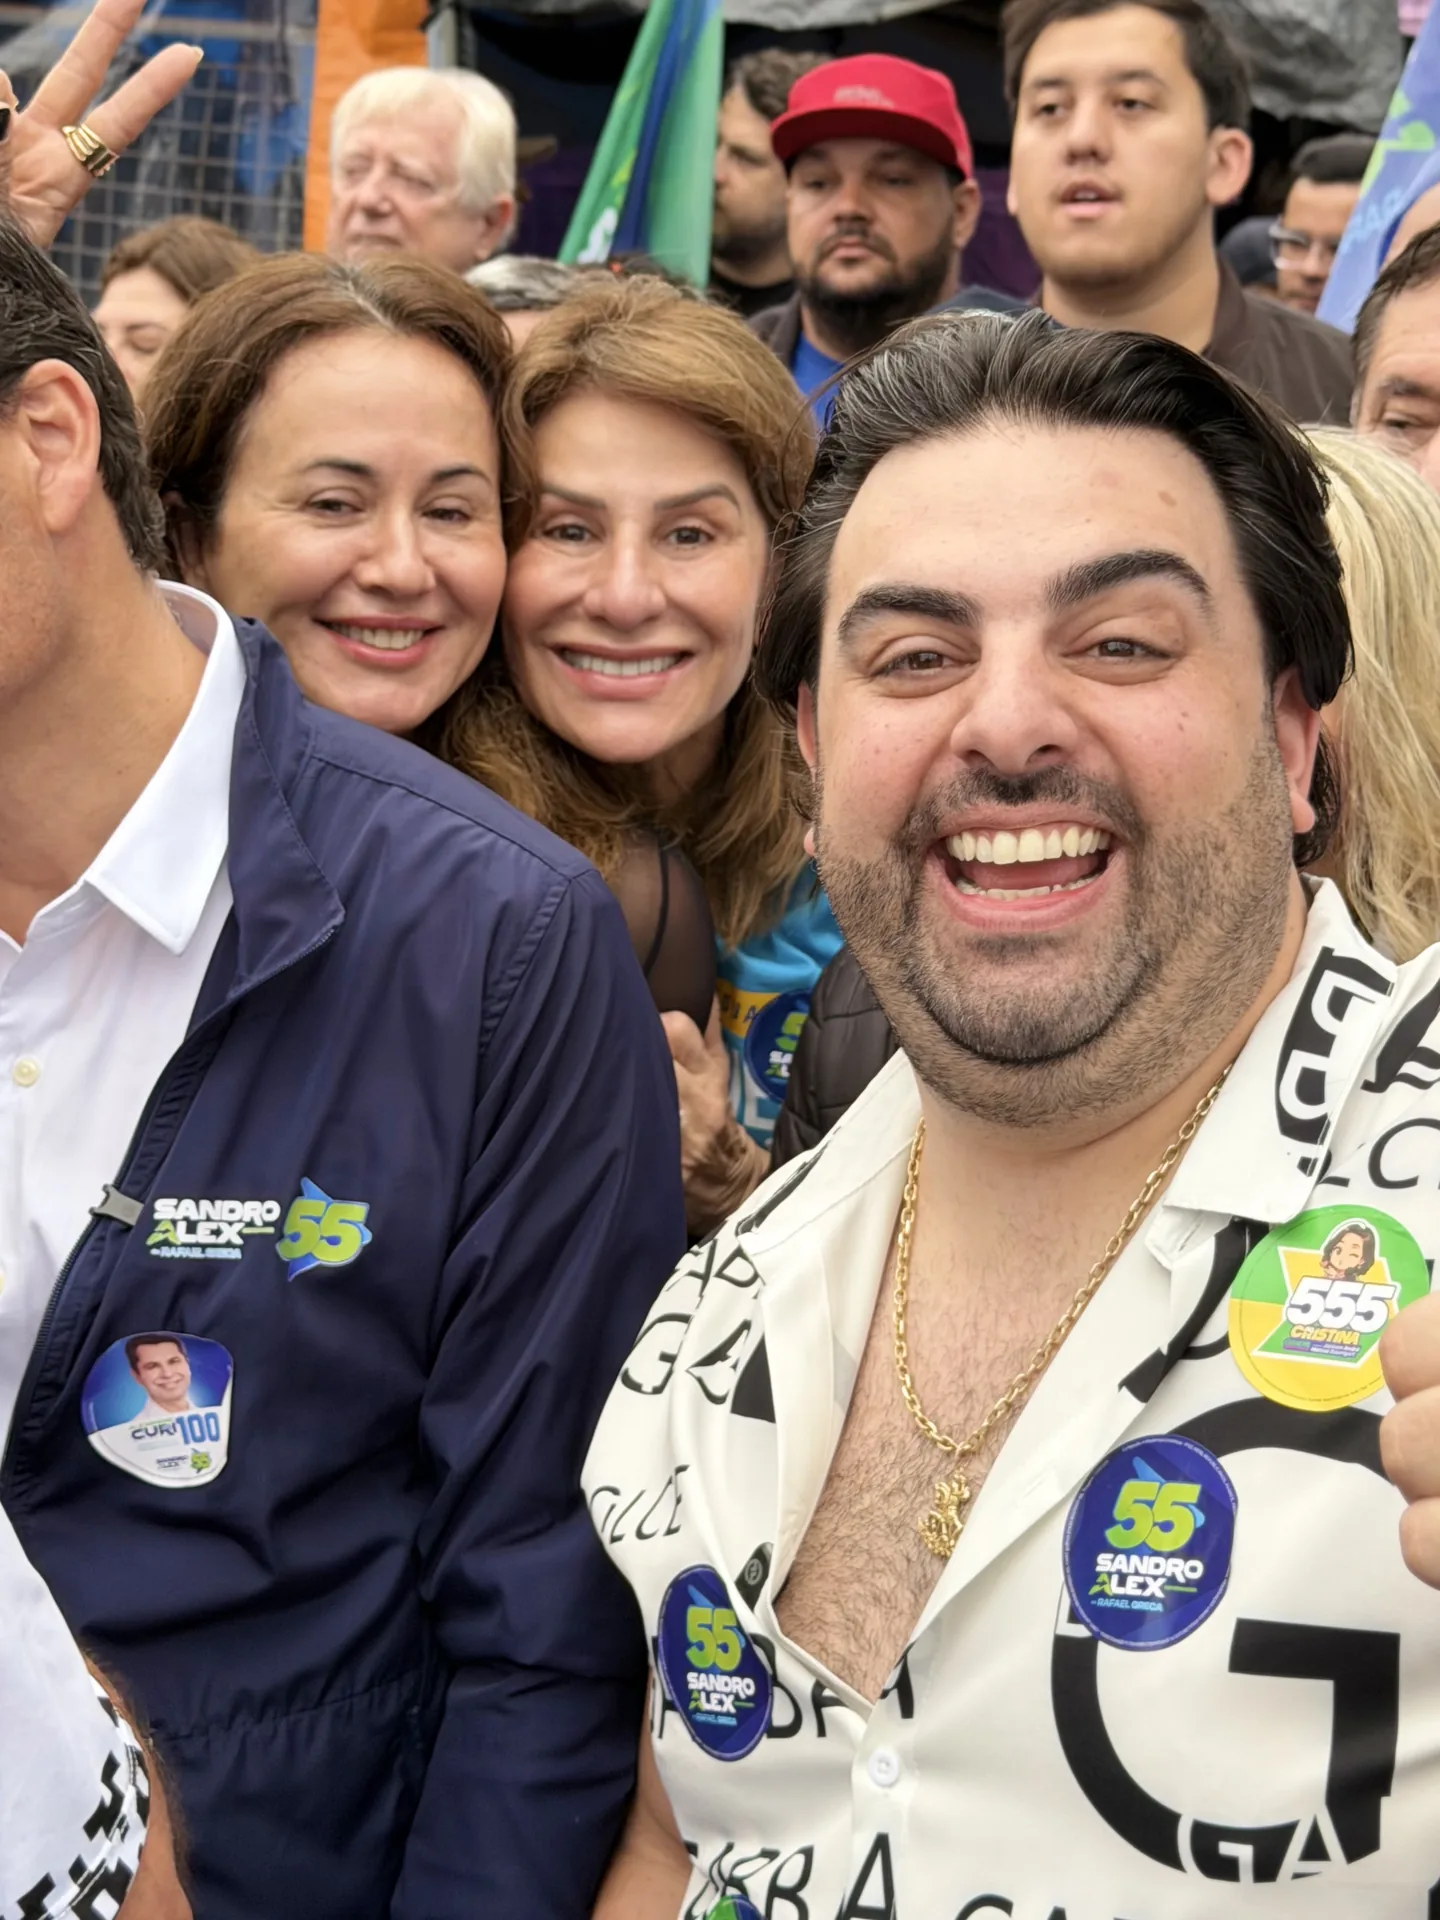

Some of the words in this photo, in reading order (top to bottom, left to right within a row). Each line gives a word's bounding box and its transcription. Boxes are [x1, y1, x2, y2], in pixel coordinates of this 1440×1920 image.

[153, 1198, 281, 1226] SANDRO
[145, 1219, 246, 1245] ALEX
[276, 1196, 370, 1268] 55
[1286, 1276, 1397, 1334] 555
[1290, 1323, 1360, 1346] CRISTINA
[176, 1412, 220, 1445] 100
[1105, 1480, 1202, 1552] 55
[1095, 1553, 1204, 1583] SANDRO
[1088, 1573, 1167, 1598] ALEX
[686, 1606, 742, 1672] 55
[686, 1672, 756, 1699] SANDRO
[688, 1691, 737, 1713] ALEX
